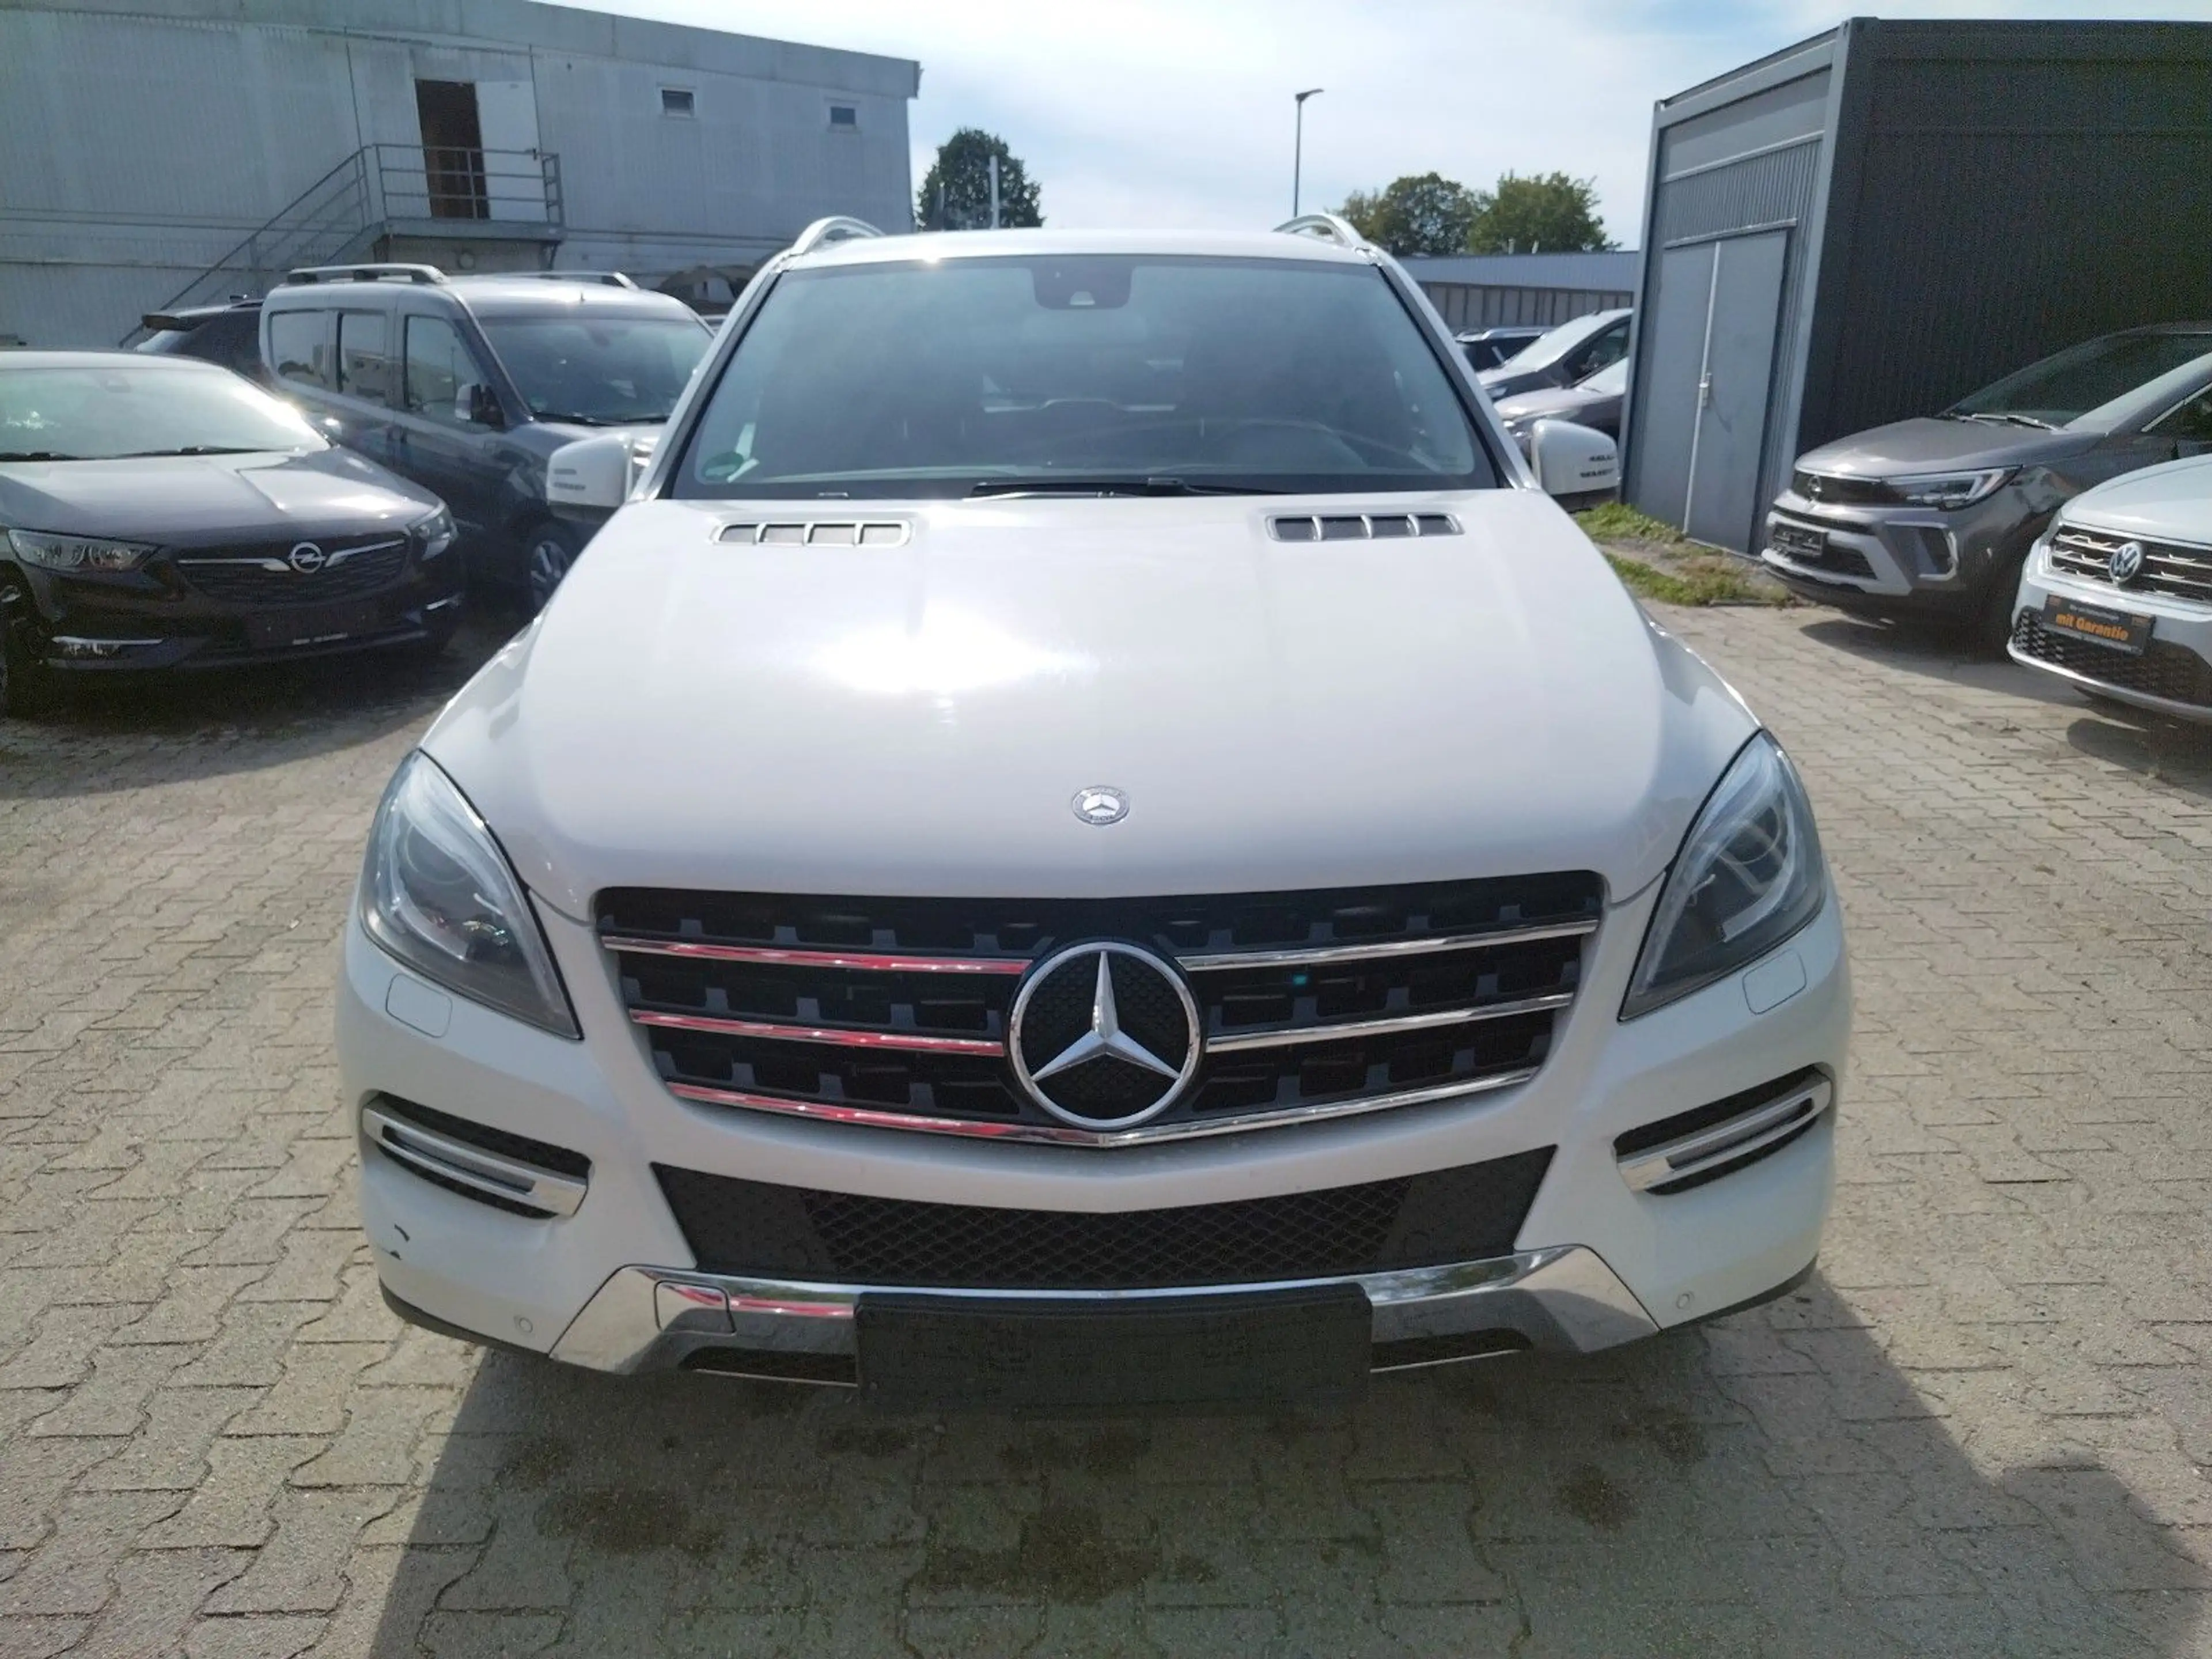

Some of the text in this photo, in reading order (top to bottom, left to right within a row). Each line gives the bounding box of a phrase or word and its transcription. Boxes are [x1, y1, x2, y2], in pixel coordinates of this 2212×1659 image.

[2109, 541, 2141, 582] VW
[2055, 613, 2129, 641] mit Garantie
